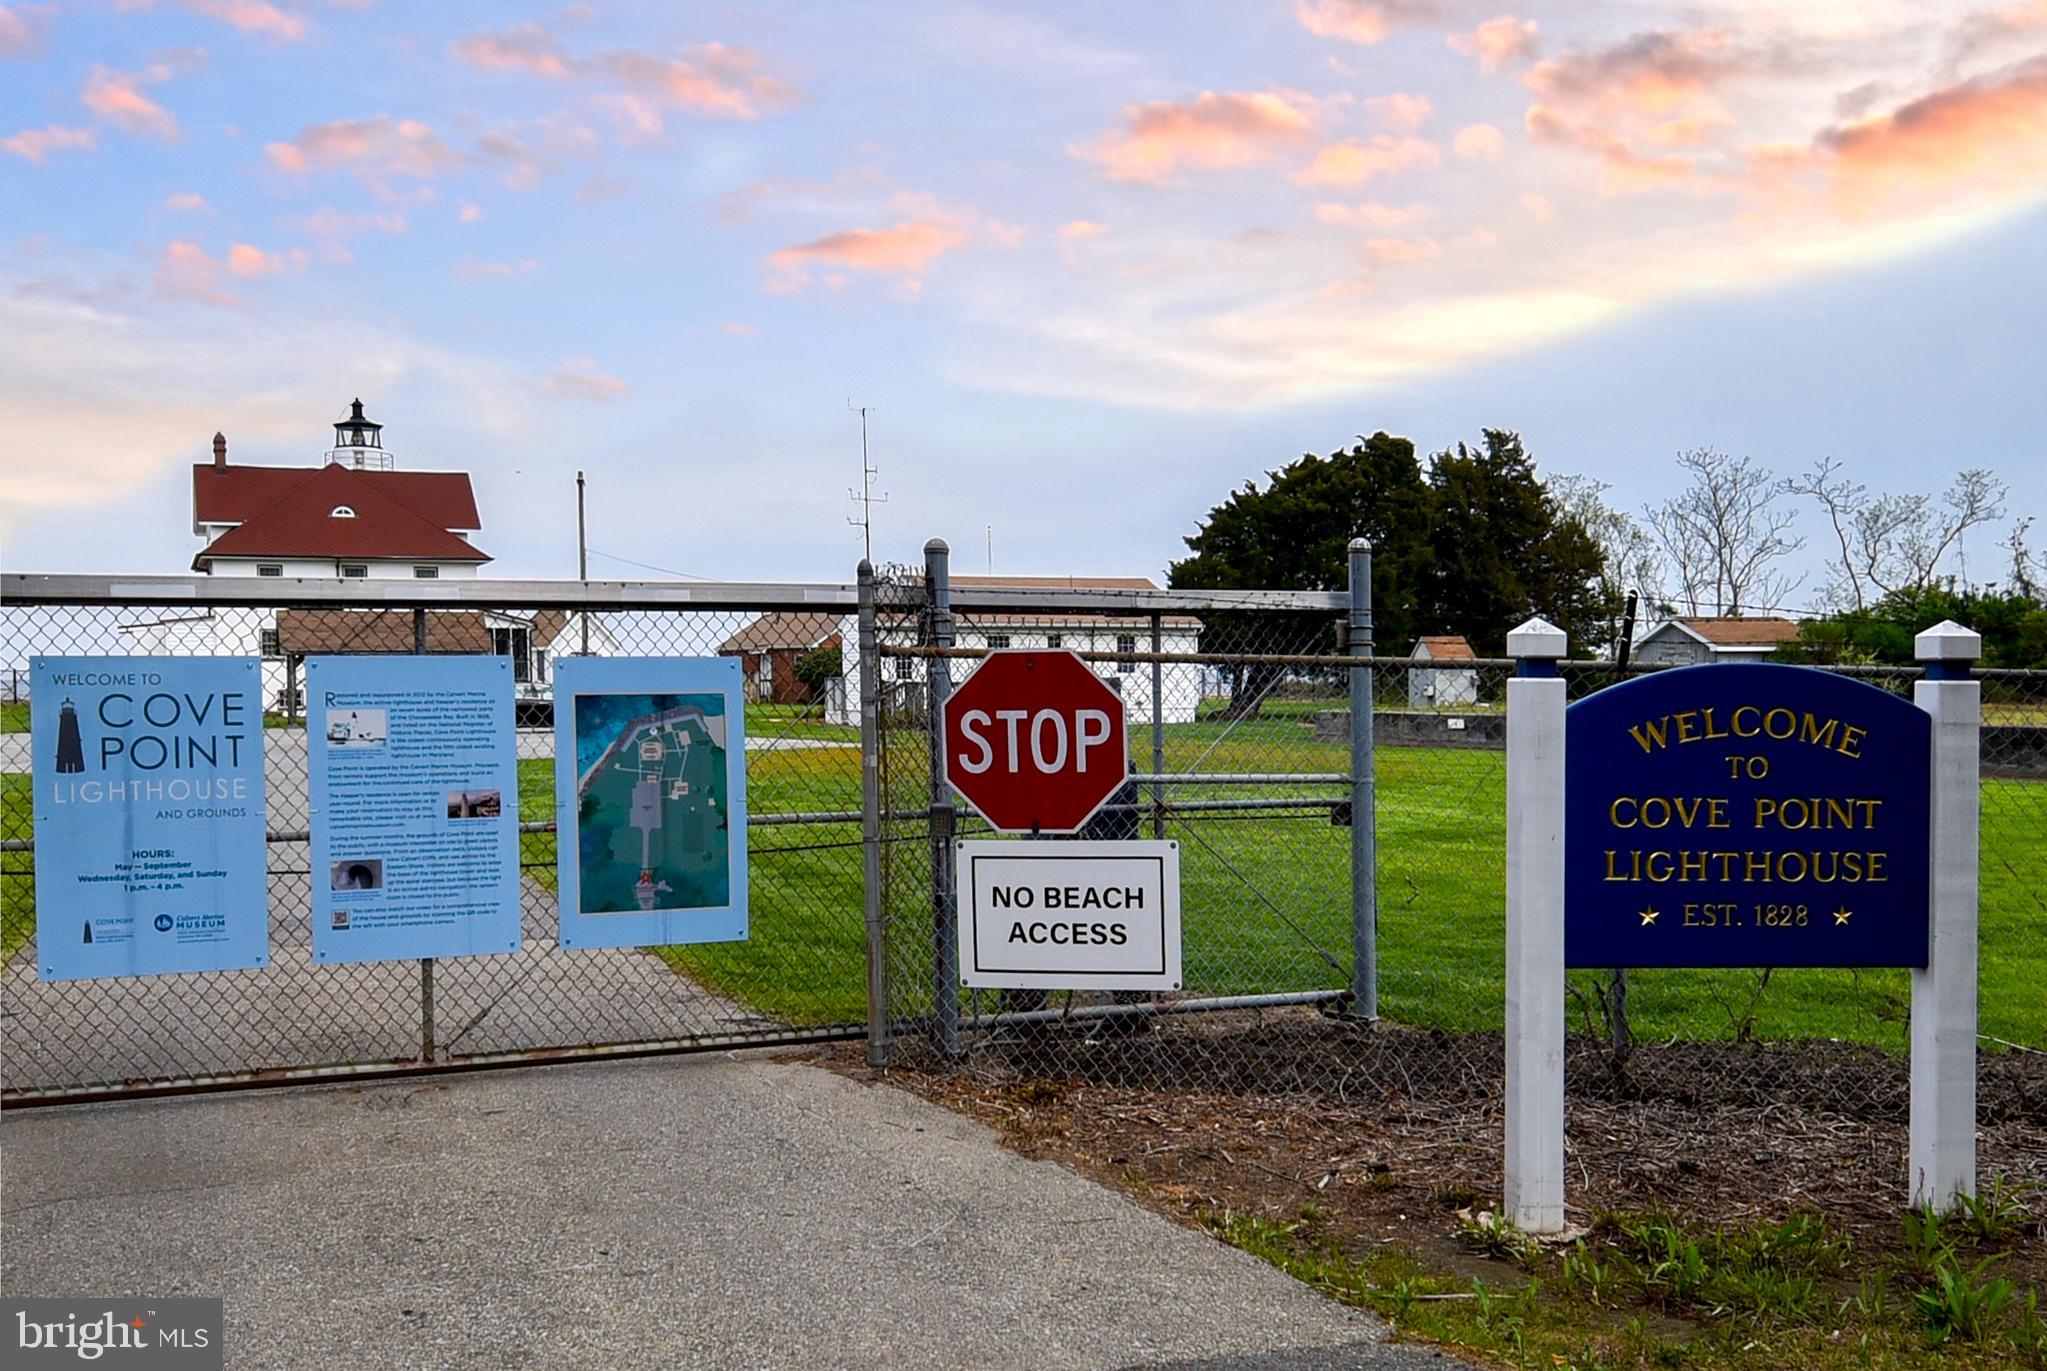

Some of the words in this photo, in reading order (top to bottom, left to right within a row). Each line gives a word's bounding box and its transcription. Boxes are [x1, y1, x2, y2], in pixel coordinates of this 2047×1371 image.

[52, 674, 136, 686] WELCOME
[140, 674, 161, 685] TO
[99, 694, 244, 728] COVE
[958, 708, 1111, 774] STOP
[1628, 706, 1868, 759] WELCOME
[102, 736, 244, 770] POINT
[1725, 755, 1769, 780] TO
[54, 778, 246, 803] LIGHTHOUSE
[156, 809, 182, 819] AND
[187, 808, 246, 819] GROUNDS
[1609, 797, 1730, 829] COVE
[1754, 798, 1882, 830] POINT
[132, 850, 175, 859] HOURS:
[1603, 850, 1888, 883] LIGHTHOUSE
[78, 874, 132, 882] Wednesday,
[135, 872, 175, 881] Saturday,
[196, 870, 227, 878] Sunday
[115, 863, 132, 872] May
[144, 862, 191, 870] September
[992, 886, 1034, 909] NO
[1044, 886, 1144, 909] BEACH
[176, 920, 225, 929] MUSEUM
[1682, 904, 1742, 927] EST.
[1754, 904, 1809, 927] 1828
[1008, 921, 1128, 945] ACCESS
